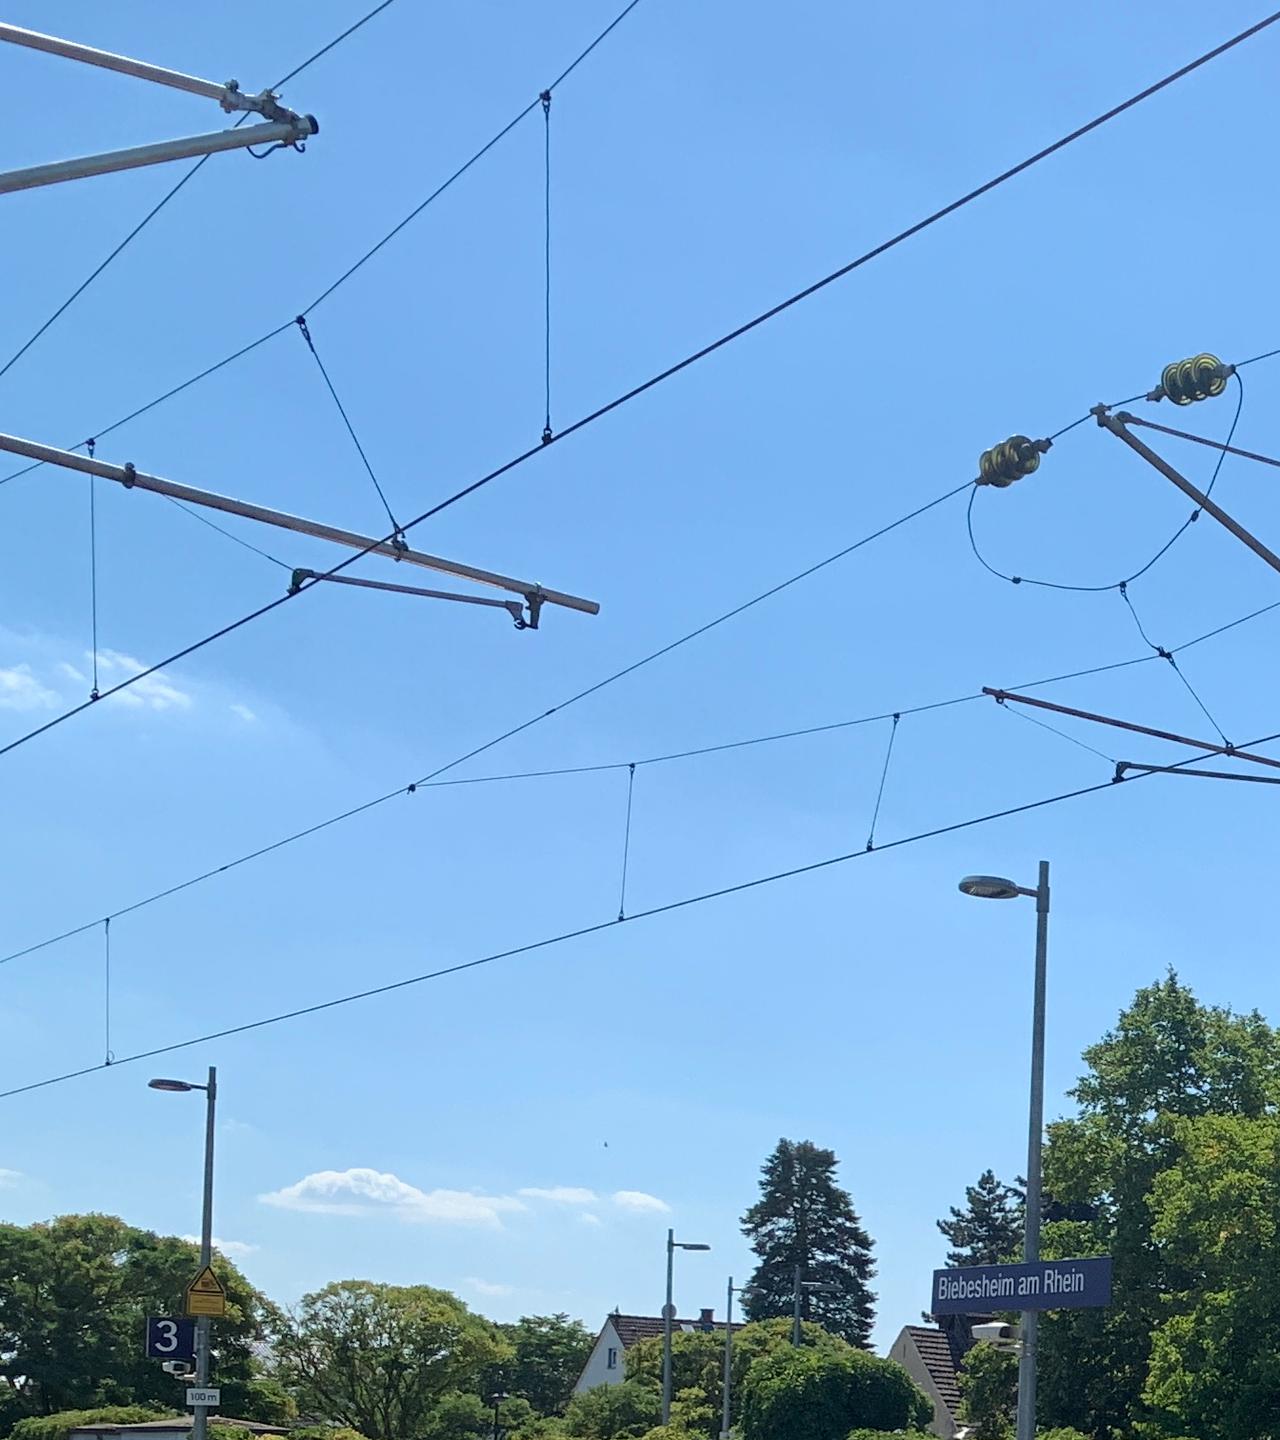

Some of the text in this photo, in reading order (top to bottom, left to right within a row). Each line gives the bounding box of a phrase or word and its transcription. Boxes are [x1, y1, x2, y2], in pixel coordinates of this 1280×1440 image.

[938, 1268, 1084, 1300] Biebesheim am Rhein
[155, 1320, 178, 1352] 3
[190, 1393, 205, 1401] 100
